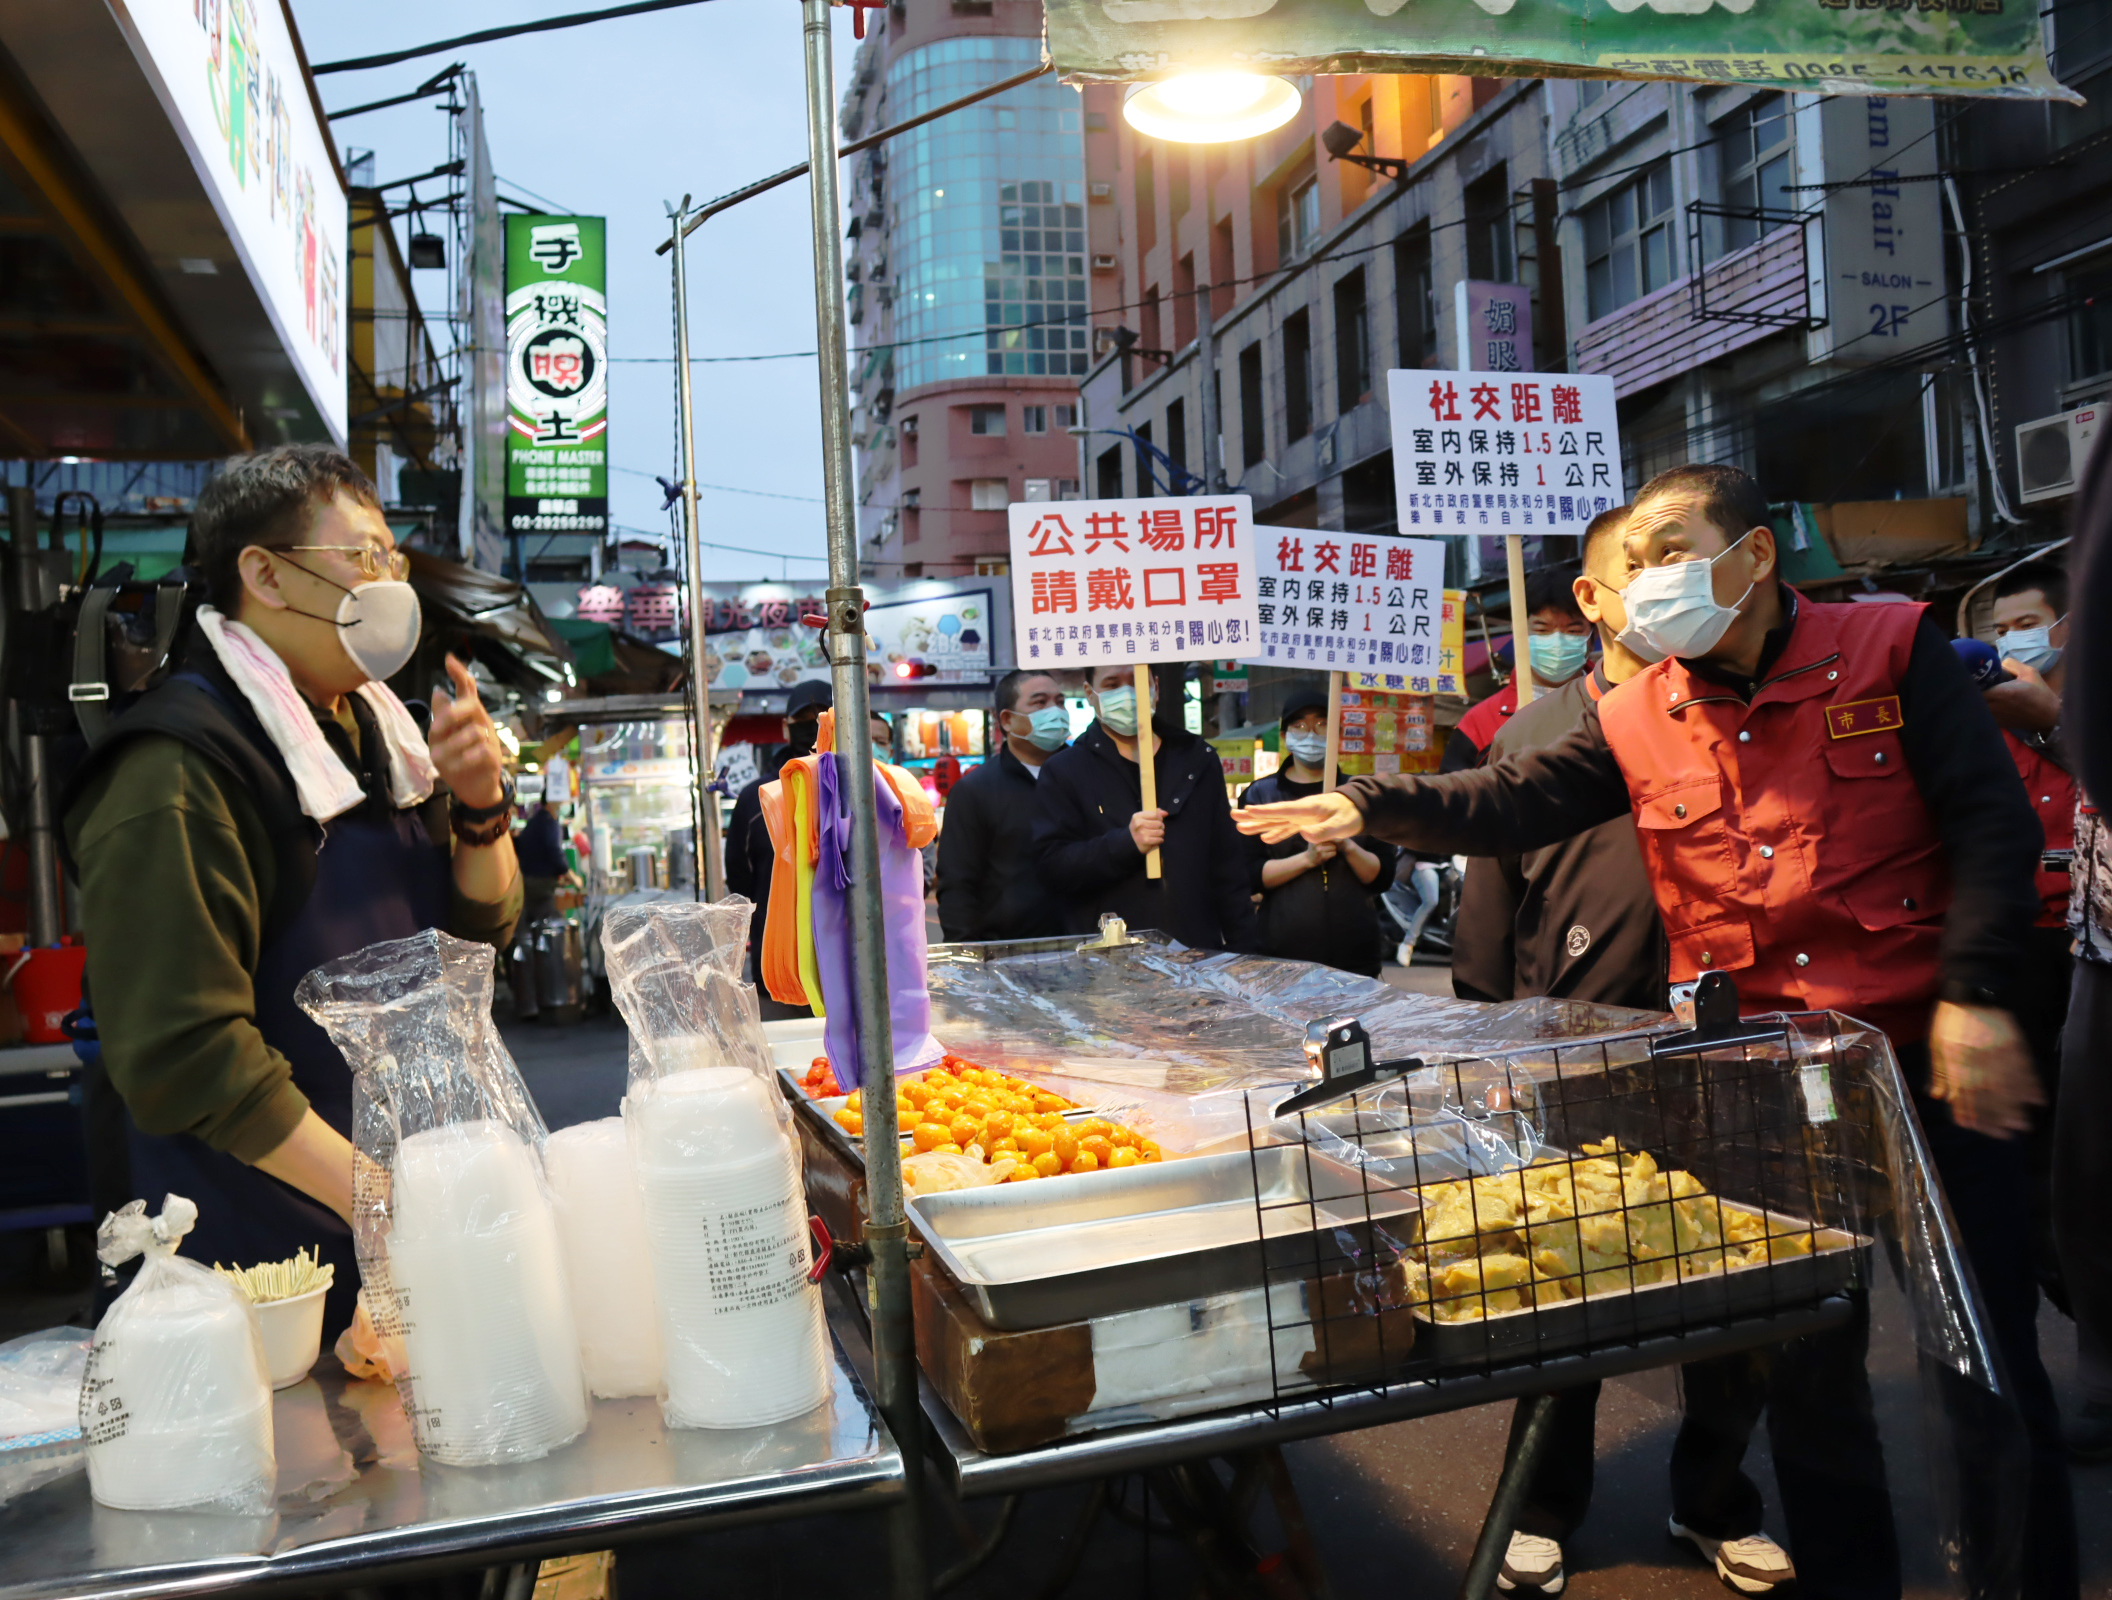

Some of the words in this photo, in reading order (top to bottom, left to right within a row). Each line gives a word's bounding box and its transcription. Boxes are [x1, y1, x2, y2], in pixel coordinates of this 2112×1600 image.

[1870, 167, 1903, 256] Hair
[1861, 271, 1912, 289] SALON
[1869, 303, 1909, 337] 2F
[1428, 380, 1583, 424] 社交距離
[512, 449, 555, 465] PHONE
[557, 450, 604, 466] MASTER
[1409, 493, 1556, 509] 新北市政府警察局永和分局
[1027, 505, 1238, 557] 公共場所
[1410, 510, 1556, 526] 樂華夜市自治會
[1276, 536, 1415, 582] 社交距離
[1031, 562, 1241, 615] 請戴口罩
[1029, 619, 1185, 643] 新北市政府警察局永和分局
[1188, 618, 1250, 646] 關心您!
[1029, 636, 1186, 659] 樂華夜市自治會
[1380, 641, 1432, 665] 關心您!
[1837, 705, 1893, 731] 市長
